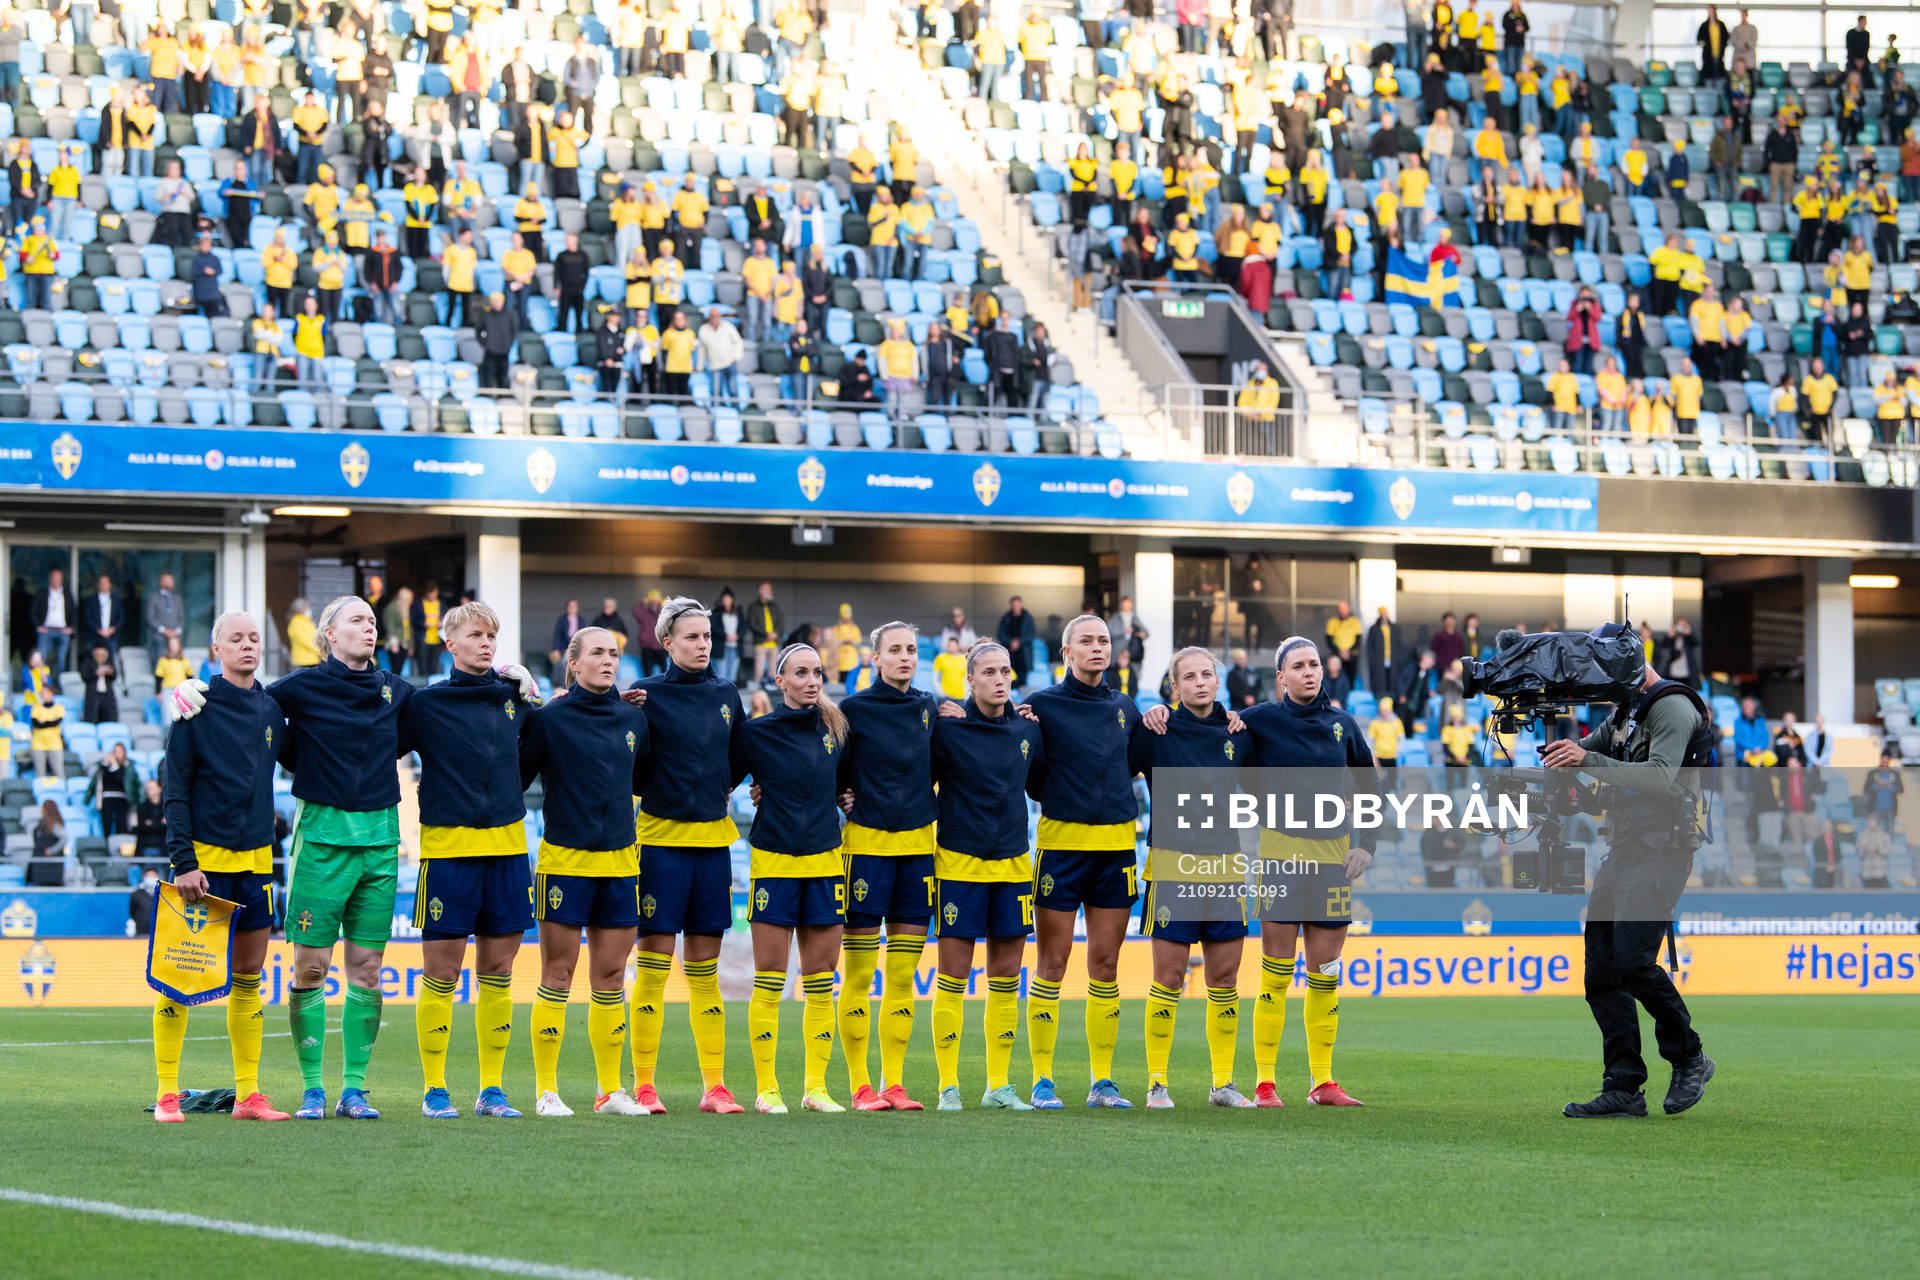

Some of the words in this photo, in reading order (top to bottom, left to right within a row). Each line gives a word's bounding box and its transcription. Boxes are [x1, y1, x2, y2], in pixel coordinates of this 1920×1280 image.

[835, 883, 846, 915] 9
[1327, 885, 1351, 917] 22
[171, 955, 203, 964] september
[181, 940, 205, 949] VM-kval
[176, 963, 205, 973] Göteborg
[1293, 946, 1569, 996] #ejasverige
[1785, 942, 1920, 988] #hejas
